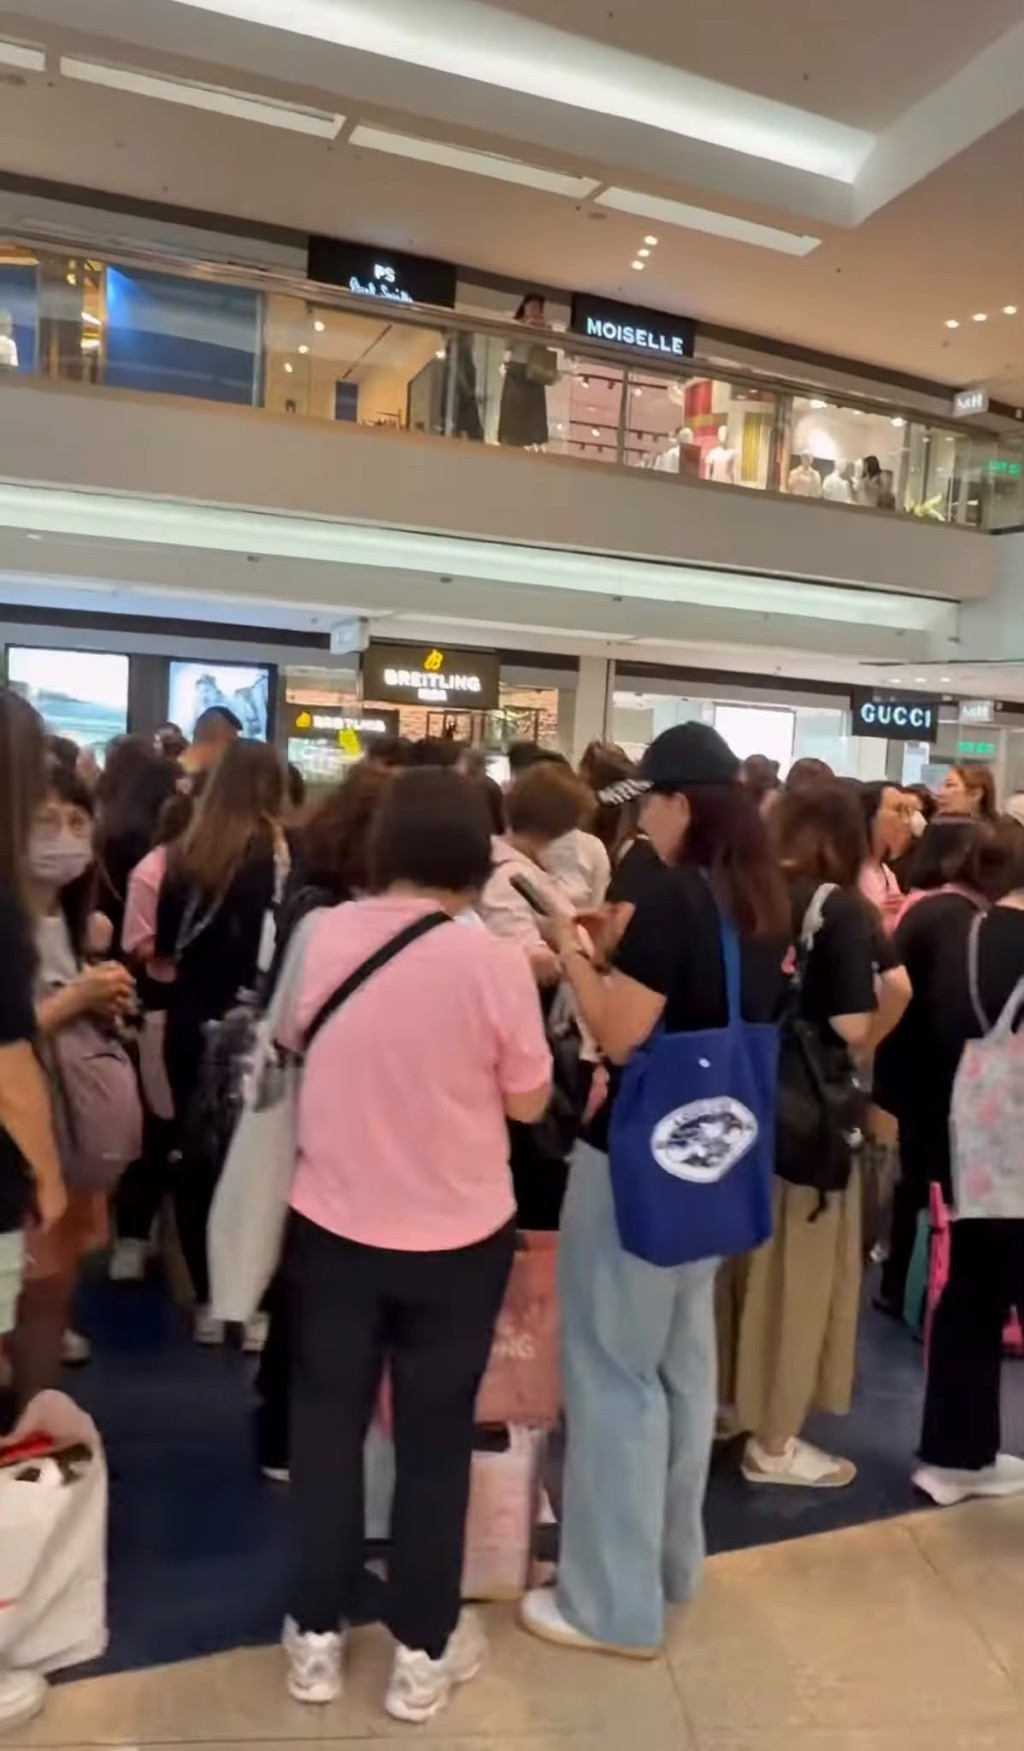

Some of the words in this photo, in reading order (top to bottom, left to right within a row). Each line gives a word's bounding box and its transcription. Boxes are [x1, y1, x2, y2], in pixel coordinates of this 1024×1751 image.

[374, 263, 396, 283] PS
[586, 316, 684, 356] MOISELLE
[384, 668, 481, 692] BREITLING
[860, 702, 932, 728] GUCCI
